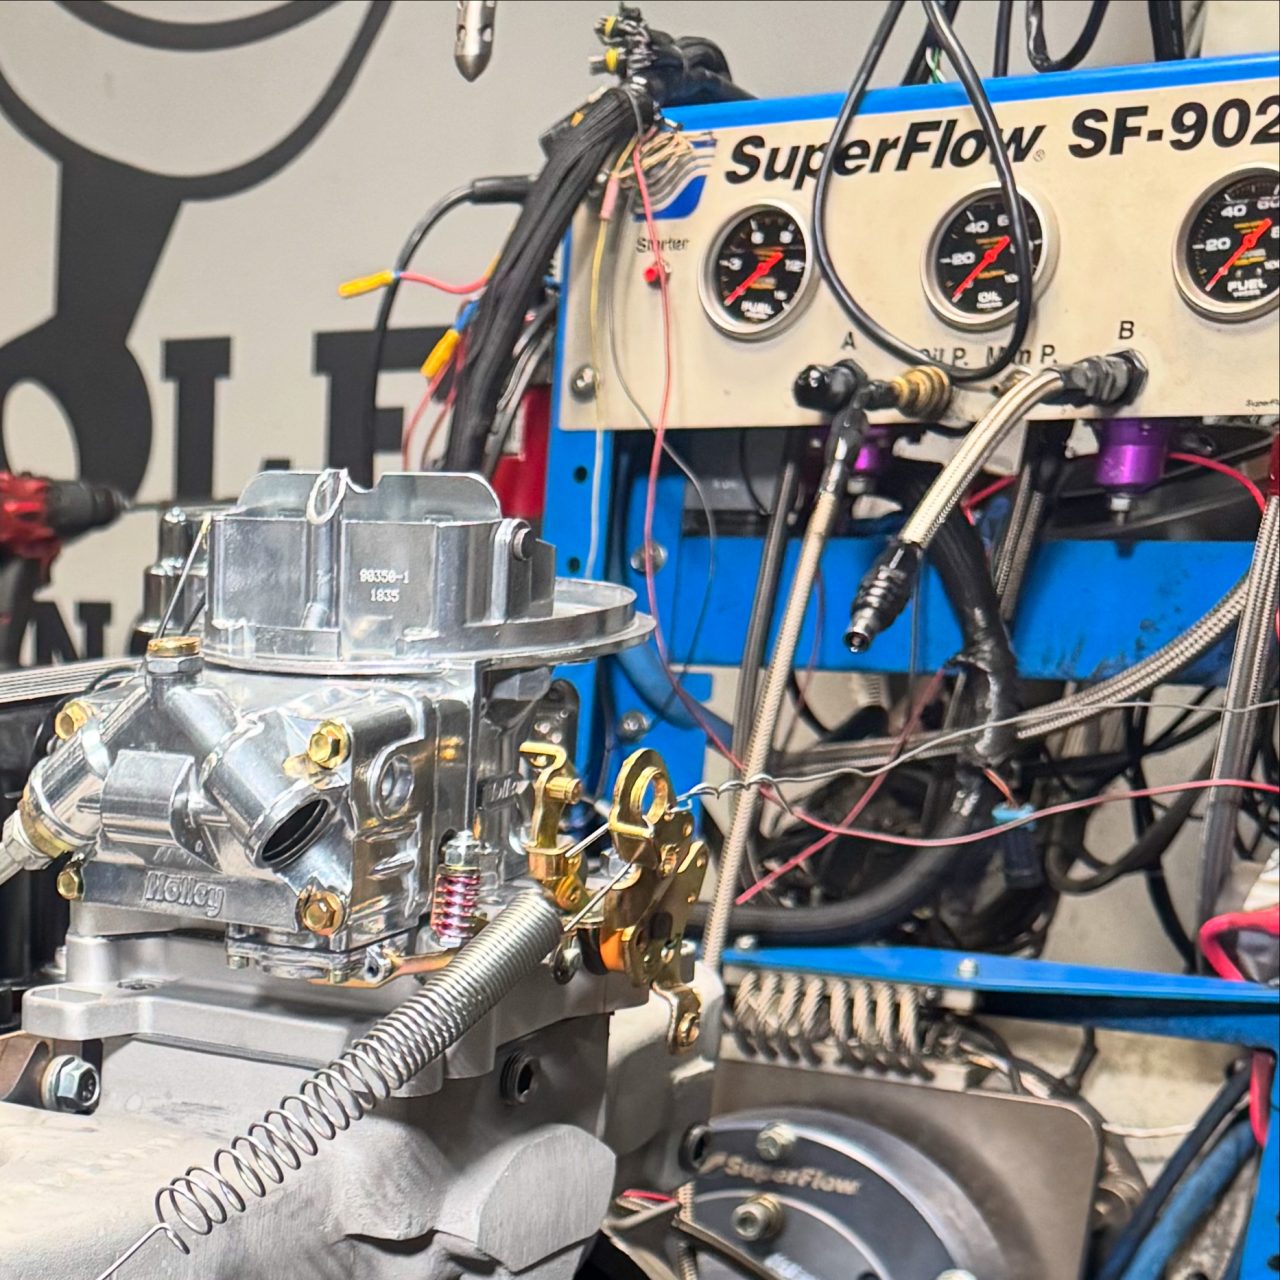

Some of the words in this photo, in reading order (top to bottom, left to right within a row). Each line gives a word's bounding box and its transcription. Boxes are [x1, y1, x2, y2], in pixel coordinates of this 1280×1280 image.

[725, 118, 1046, 191] SuperFlow
[1068, 95, 1279, 160] SF-902
[636, 237, 689, 253] Strter
[1227, 278, 1267, 293] FUEL
[977, 290, 1003, 303] OIL
[1118, 320, 1135, 340] B
[841, 331, 855, 350] A
[952, 347, 969, 366] P.
[986, 345, 1031, 366] Mn
[1039, 344, 1058, 365] P.
[370, 588, 400, 603] 1835
[144, 870, 226, 917] Holley
[724, 1155, 862, 1196] SuperFlow
